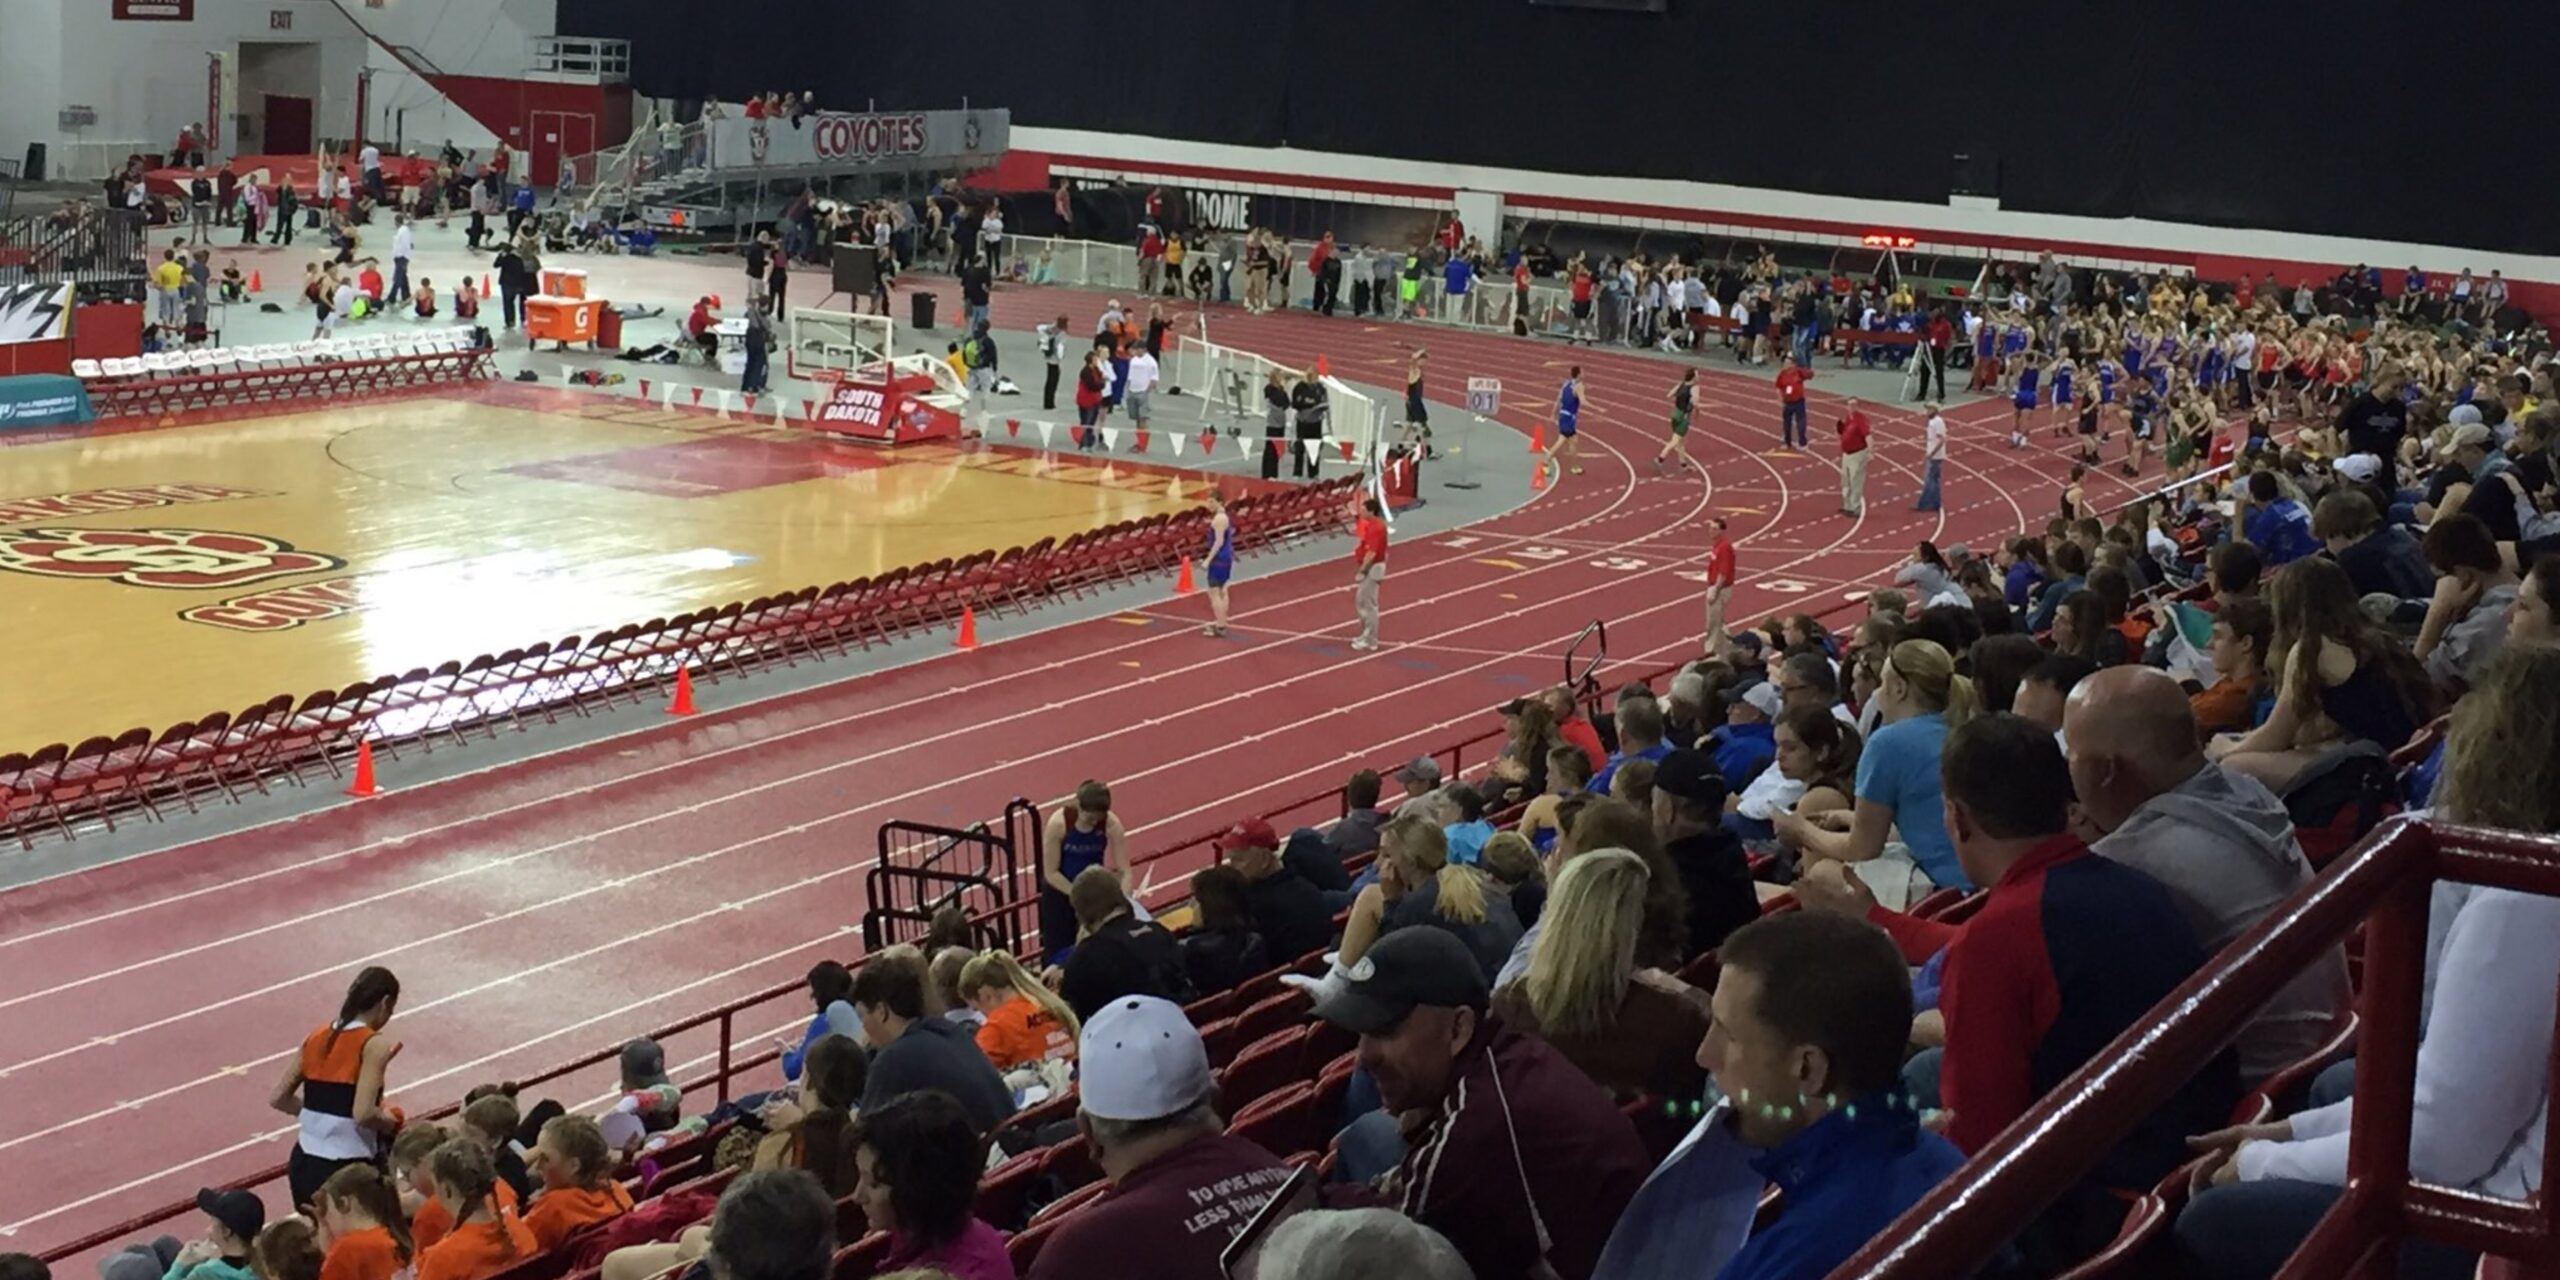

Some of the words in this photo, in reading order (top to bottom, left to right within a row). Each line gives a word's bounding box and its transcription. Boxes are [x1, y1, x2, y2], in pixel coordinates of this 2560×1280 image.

[269, 10, 293, 30] EXIT
[813, 114, 929, 161] COYOTES
[1196, 191, 1251, 231] DOME
[575, 306, 589, 329] G
[836, 389, 885, 409] SOUTH
[1471, 392, 1494, 409] 01
[824, 404, 882, 427] DAKOTA
[1507, 546, 1569, 560] 2
[1589, 557, 1648, 571] 3
[1186, 1186, 1214, 1206] TO
[1213, 1175, 1249, 1197] GIVE
[1183, 1204, 1231, 1234] LESS
[1227, 1192, 1267, 1216] THAN
